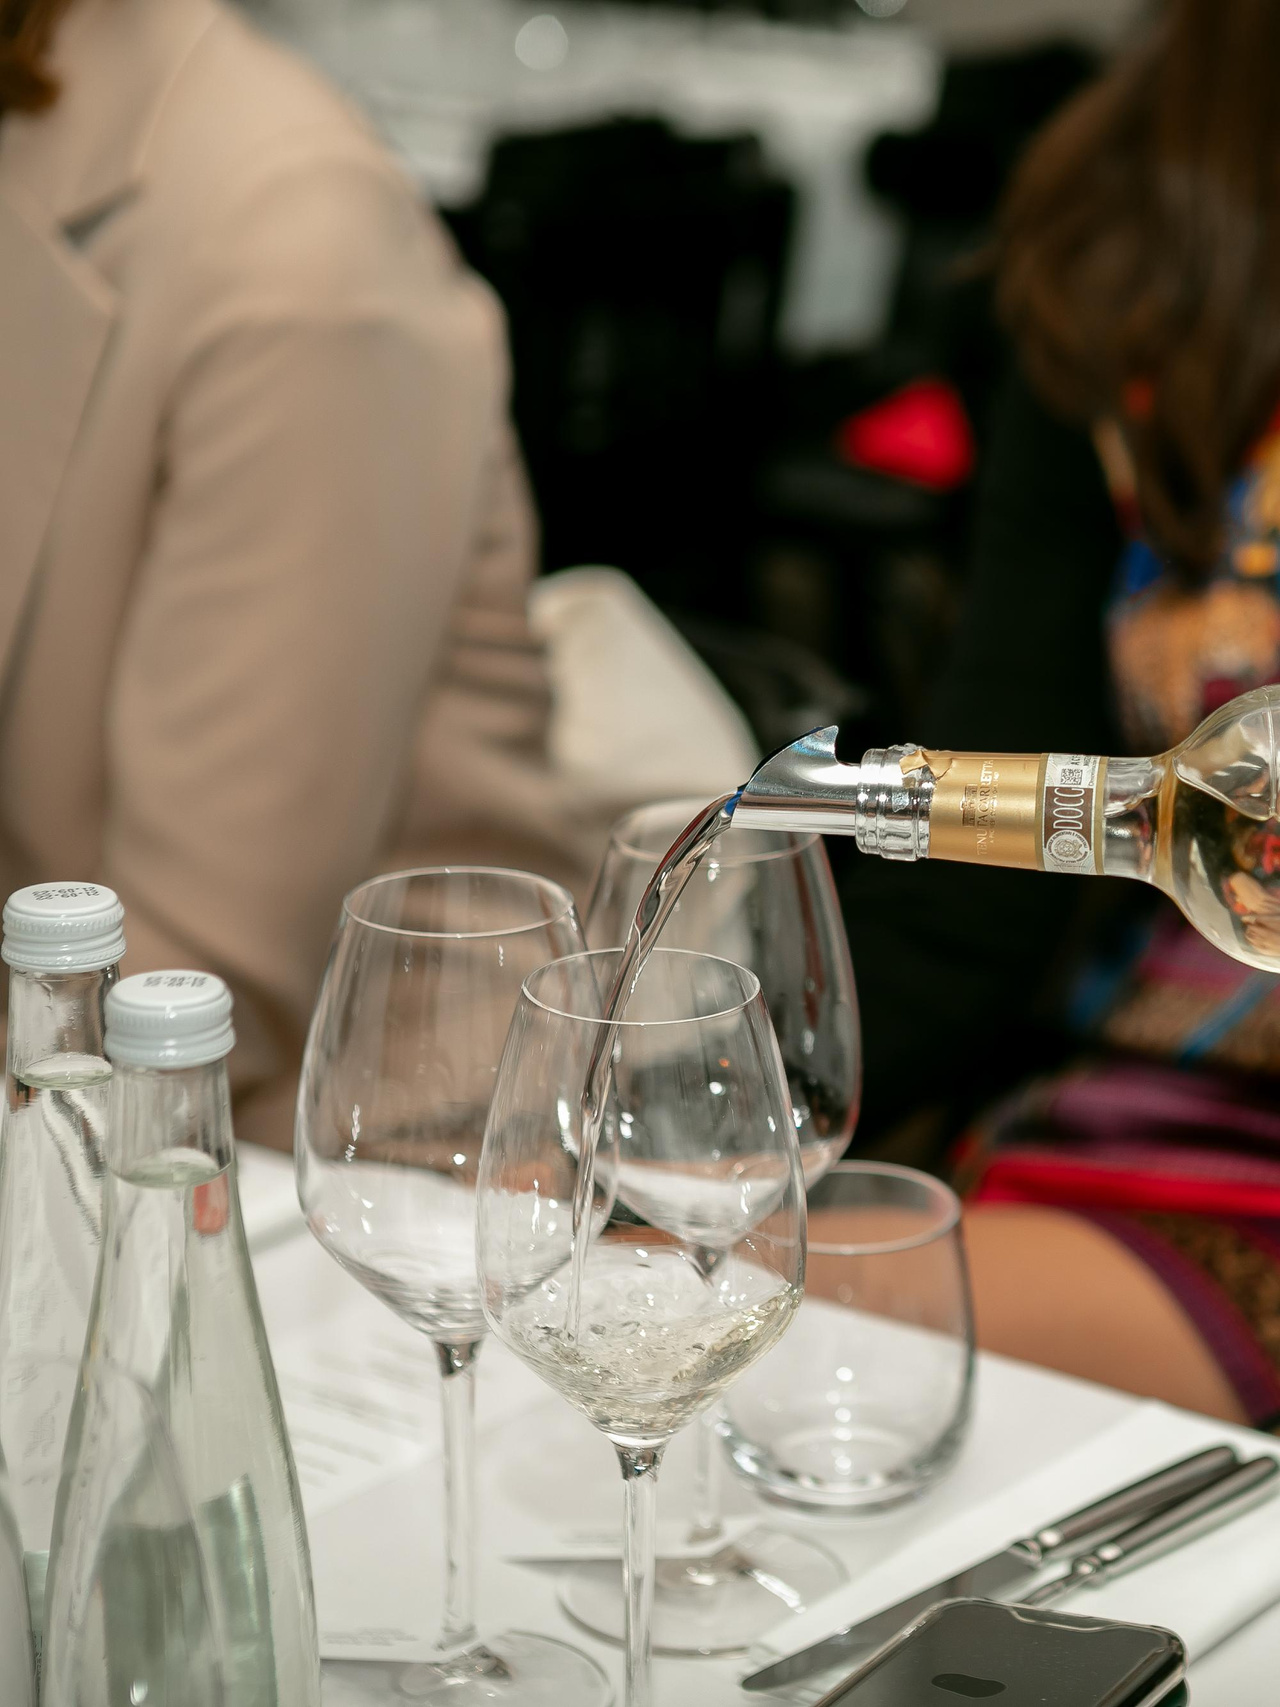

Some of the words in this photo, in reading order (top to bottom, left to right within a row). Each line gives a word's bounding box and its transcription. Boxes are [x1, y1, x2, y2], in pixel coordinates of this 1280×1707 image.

[978, 760, 994, 812] CARRETTA
[1053, 787, 1085, 830] DOCG
[977, 813, 989, 856] TENUTA
